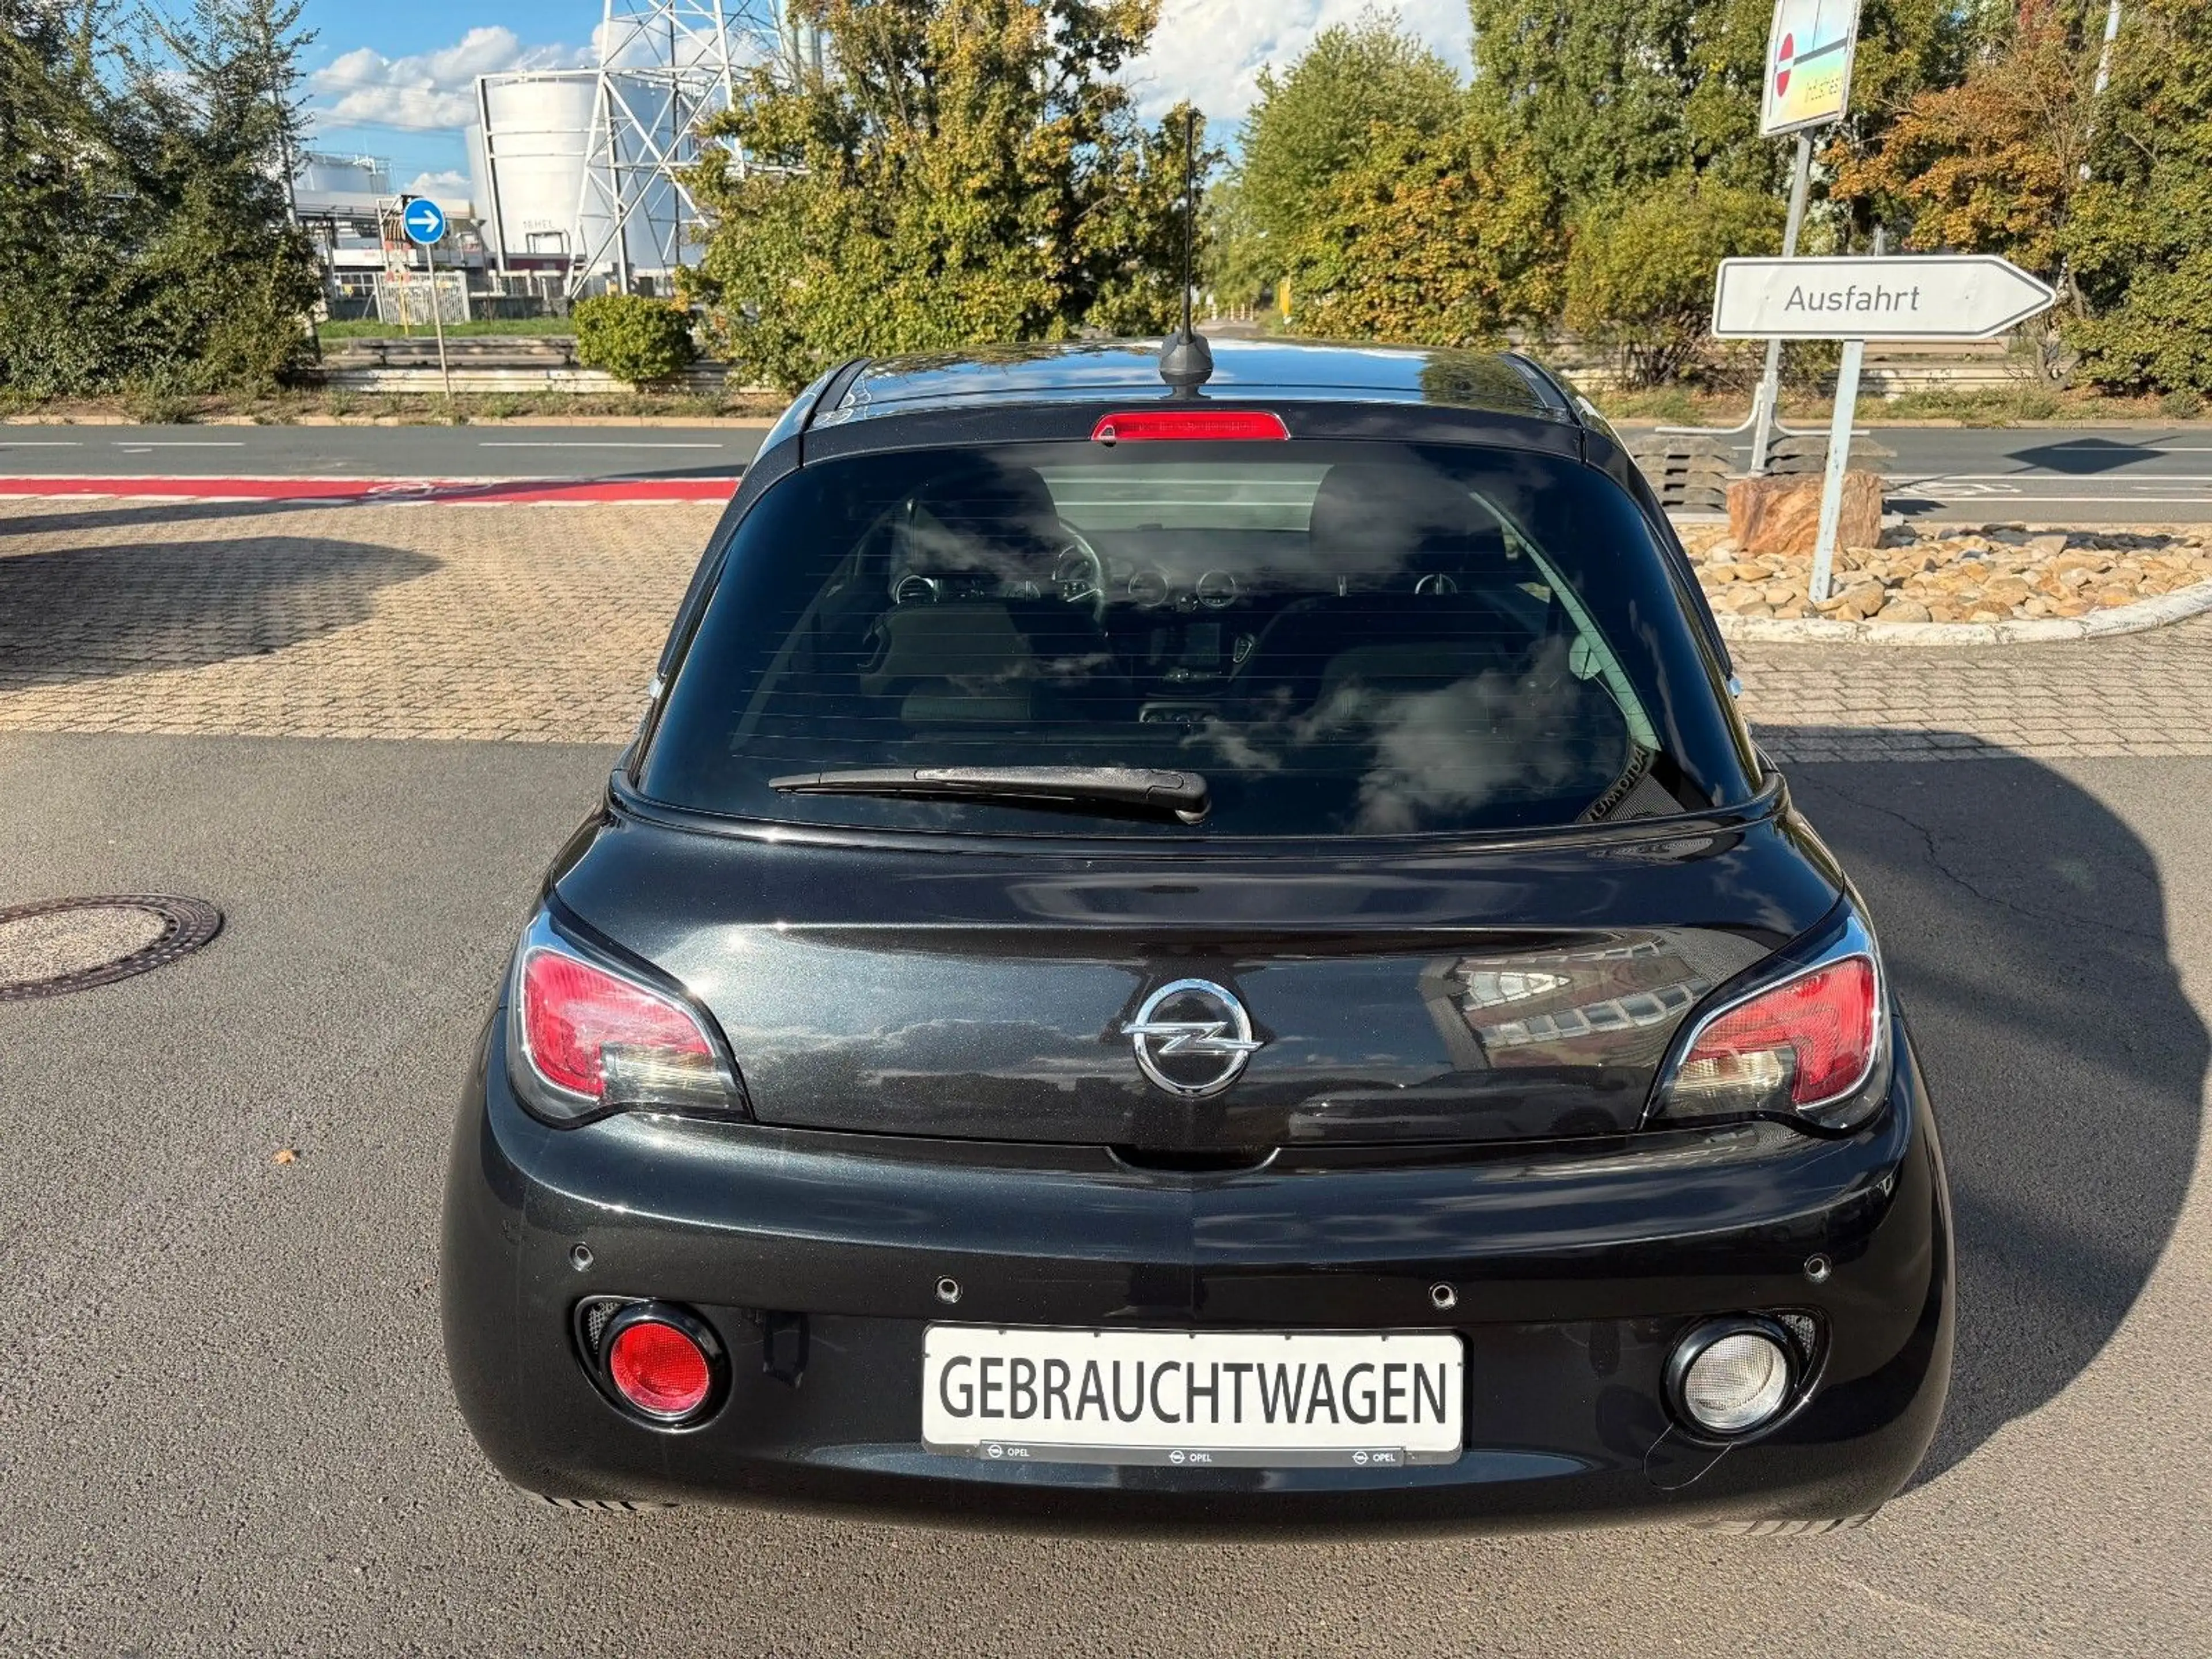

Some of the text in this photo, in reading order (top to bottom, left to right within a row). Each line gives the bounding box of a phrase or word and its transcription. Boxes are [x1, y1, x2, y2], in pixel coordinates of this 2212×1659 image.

[1784, 285, 1920, 311] Ausfahrt
[940, 1355, 1446, 1425] GEBRAUCHTWAGEN
[1007, 1448, 1030, 1457] OPEL
[1190, 1453, 1213, 1463] OPEL
[1373, 1453, 1396, 1463] OPEL
